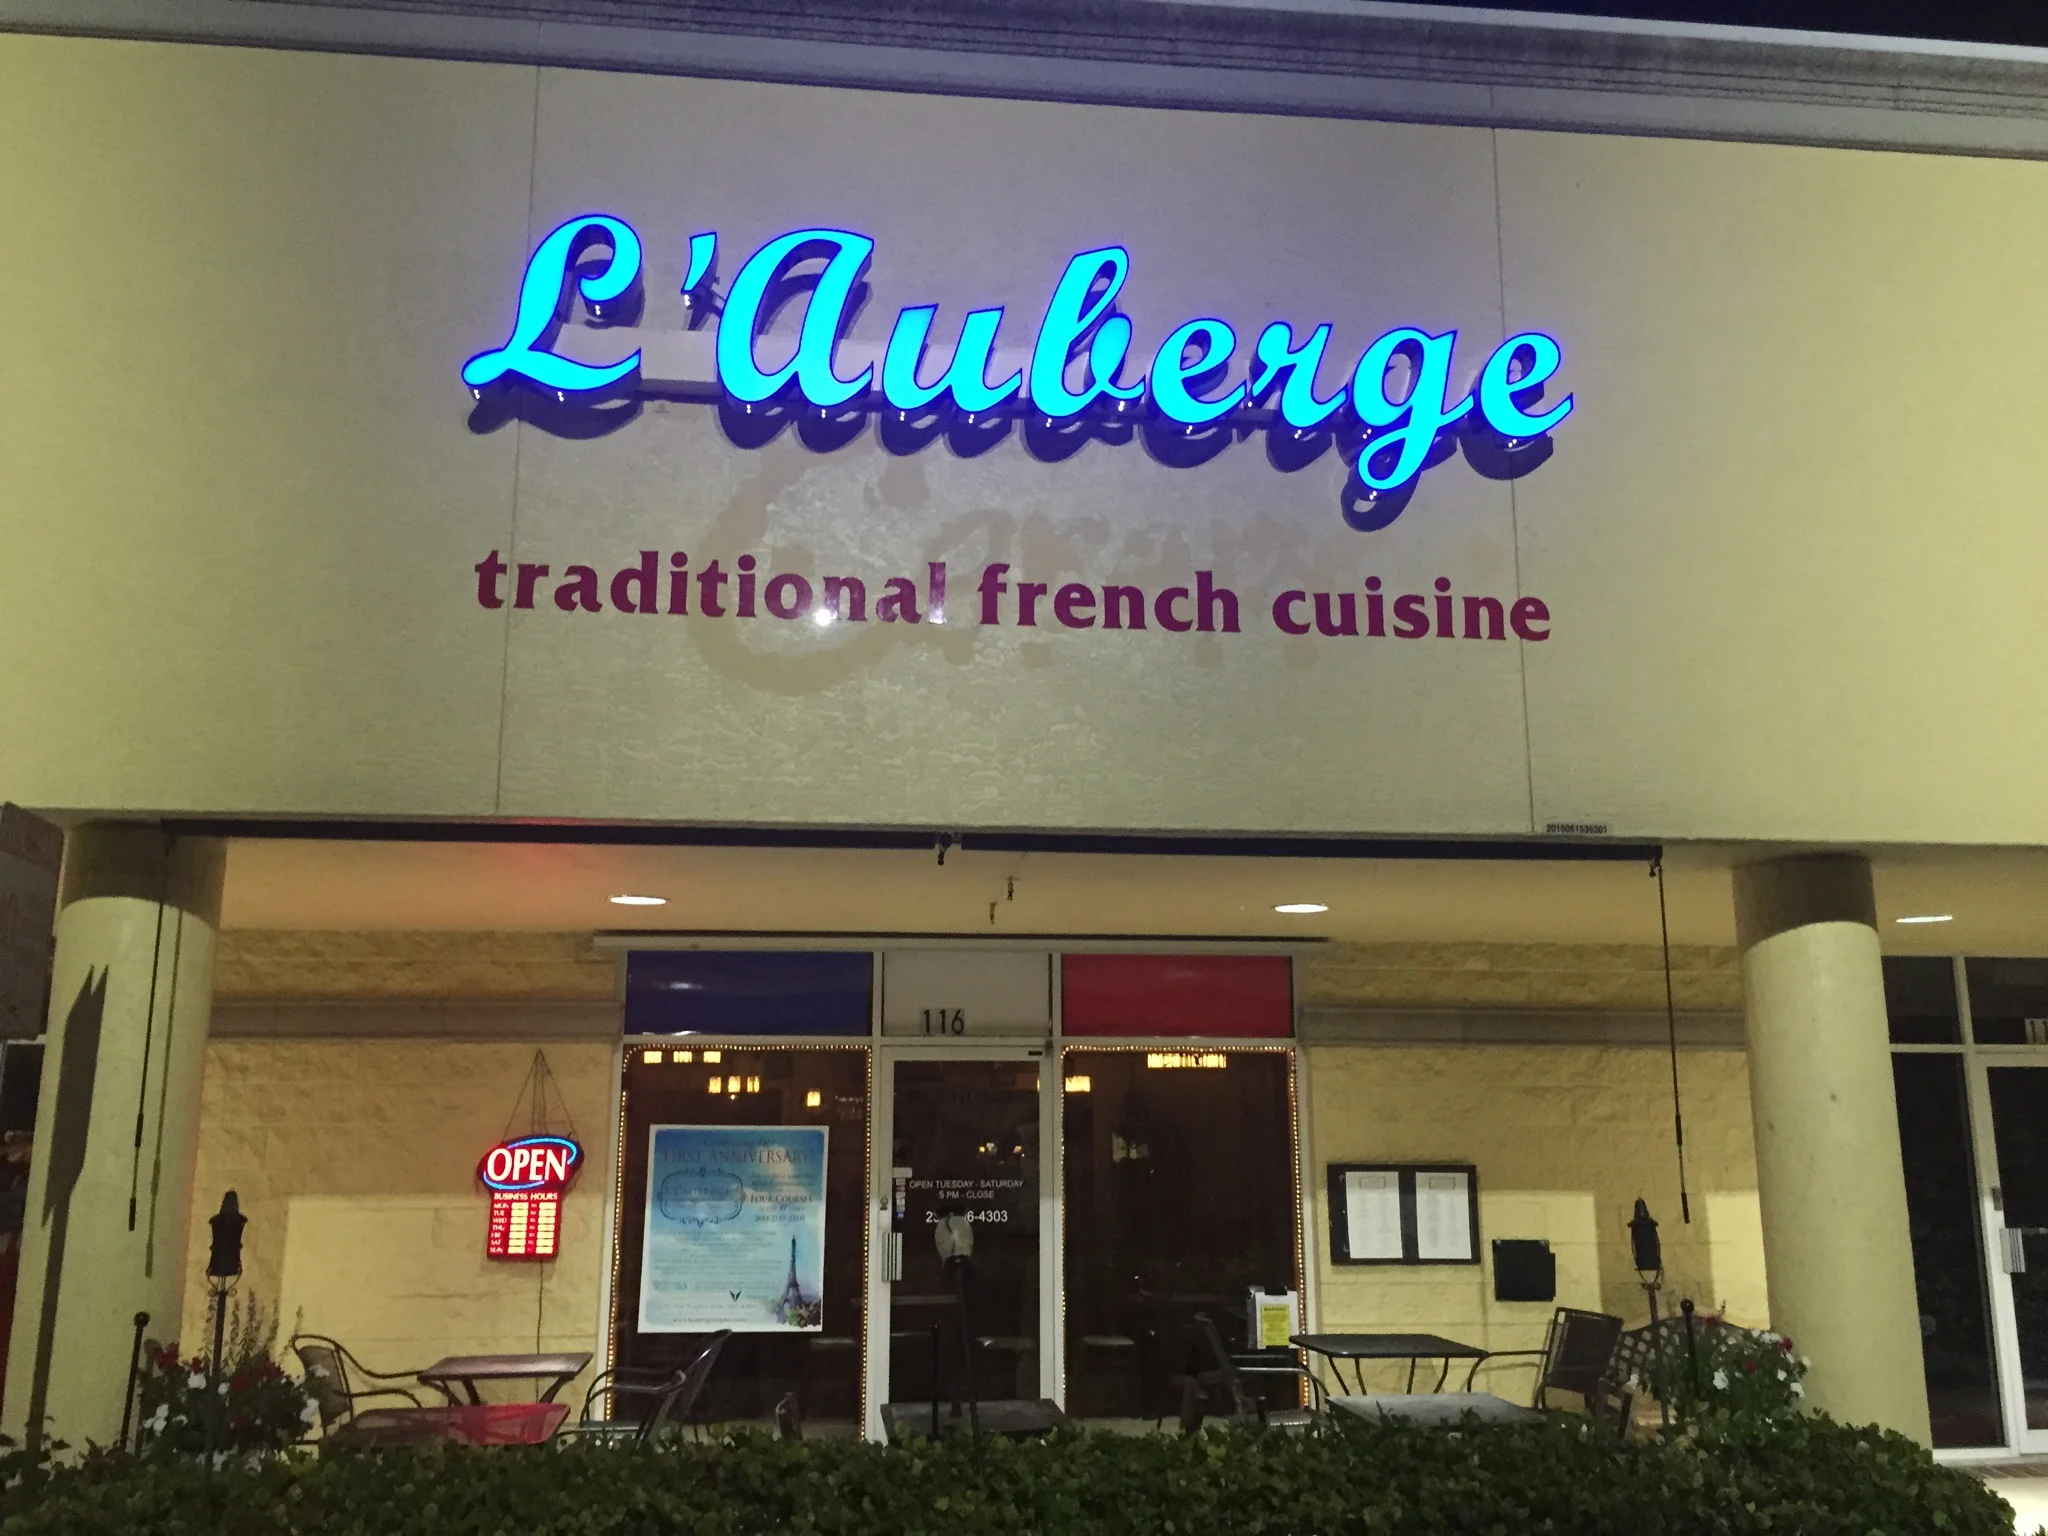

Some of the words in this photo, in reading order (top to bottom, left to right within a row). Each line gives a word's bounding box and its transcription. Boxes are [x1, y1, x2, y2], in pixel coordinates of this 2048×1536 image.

[461, 213, 1574, 491] L'Auberge
[474, 549, 947, 625] traditional
[977, 563, 1241, 634] french
[1272, 576, 1551, 641] cuisine
[923, 1009, 965, 1036] 116
[663, 1148, 702, 1164] FIRST
[487, 1147, 567, 1182] OPEN
[909, 1179, 933, 1189] OPEN
[935, 1179, 974, 1189] TUESDAY
[980, 1179, 1024, 1189] SATURDAY
[493, 1192, 528, 1201] BUSINESS
[530, 1192, 558, 1201] HOURS
[775, 1193, 813, 1203] COURSES
[938, 1190, 944, 1199] 5
[946, 1190, 959, 1199] PM
[966, 1190, 995, 1199] CLOSE
